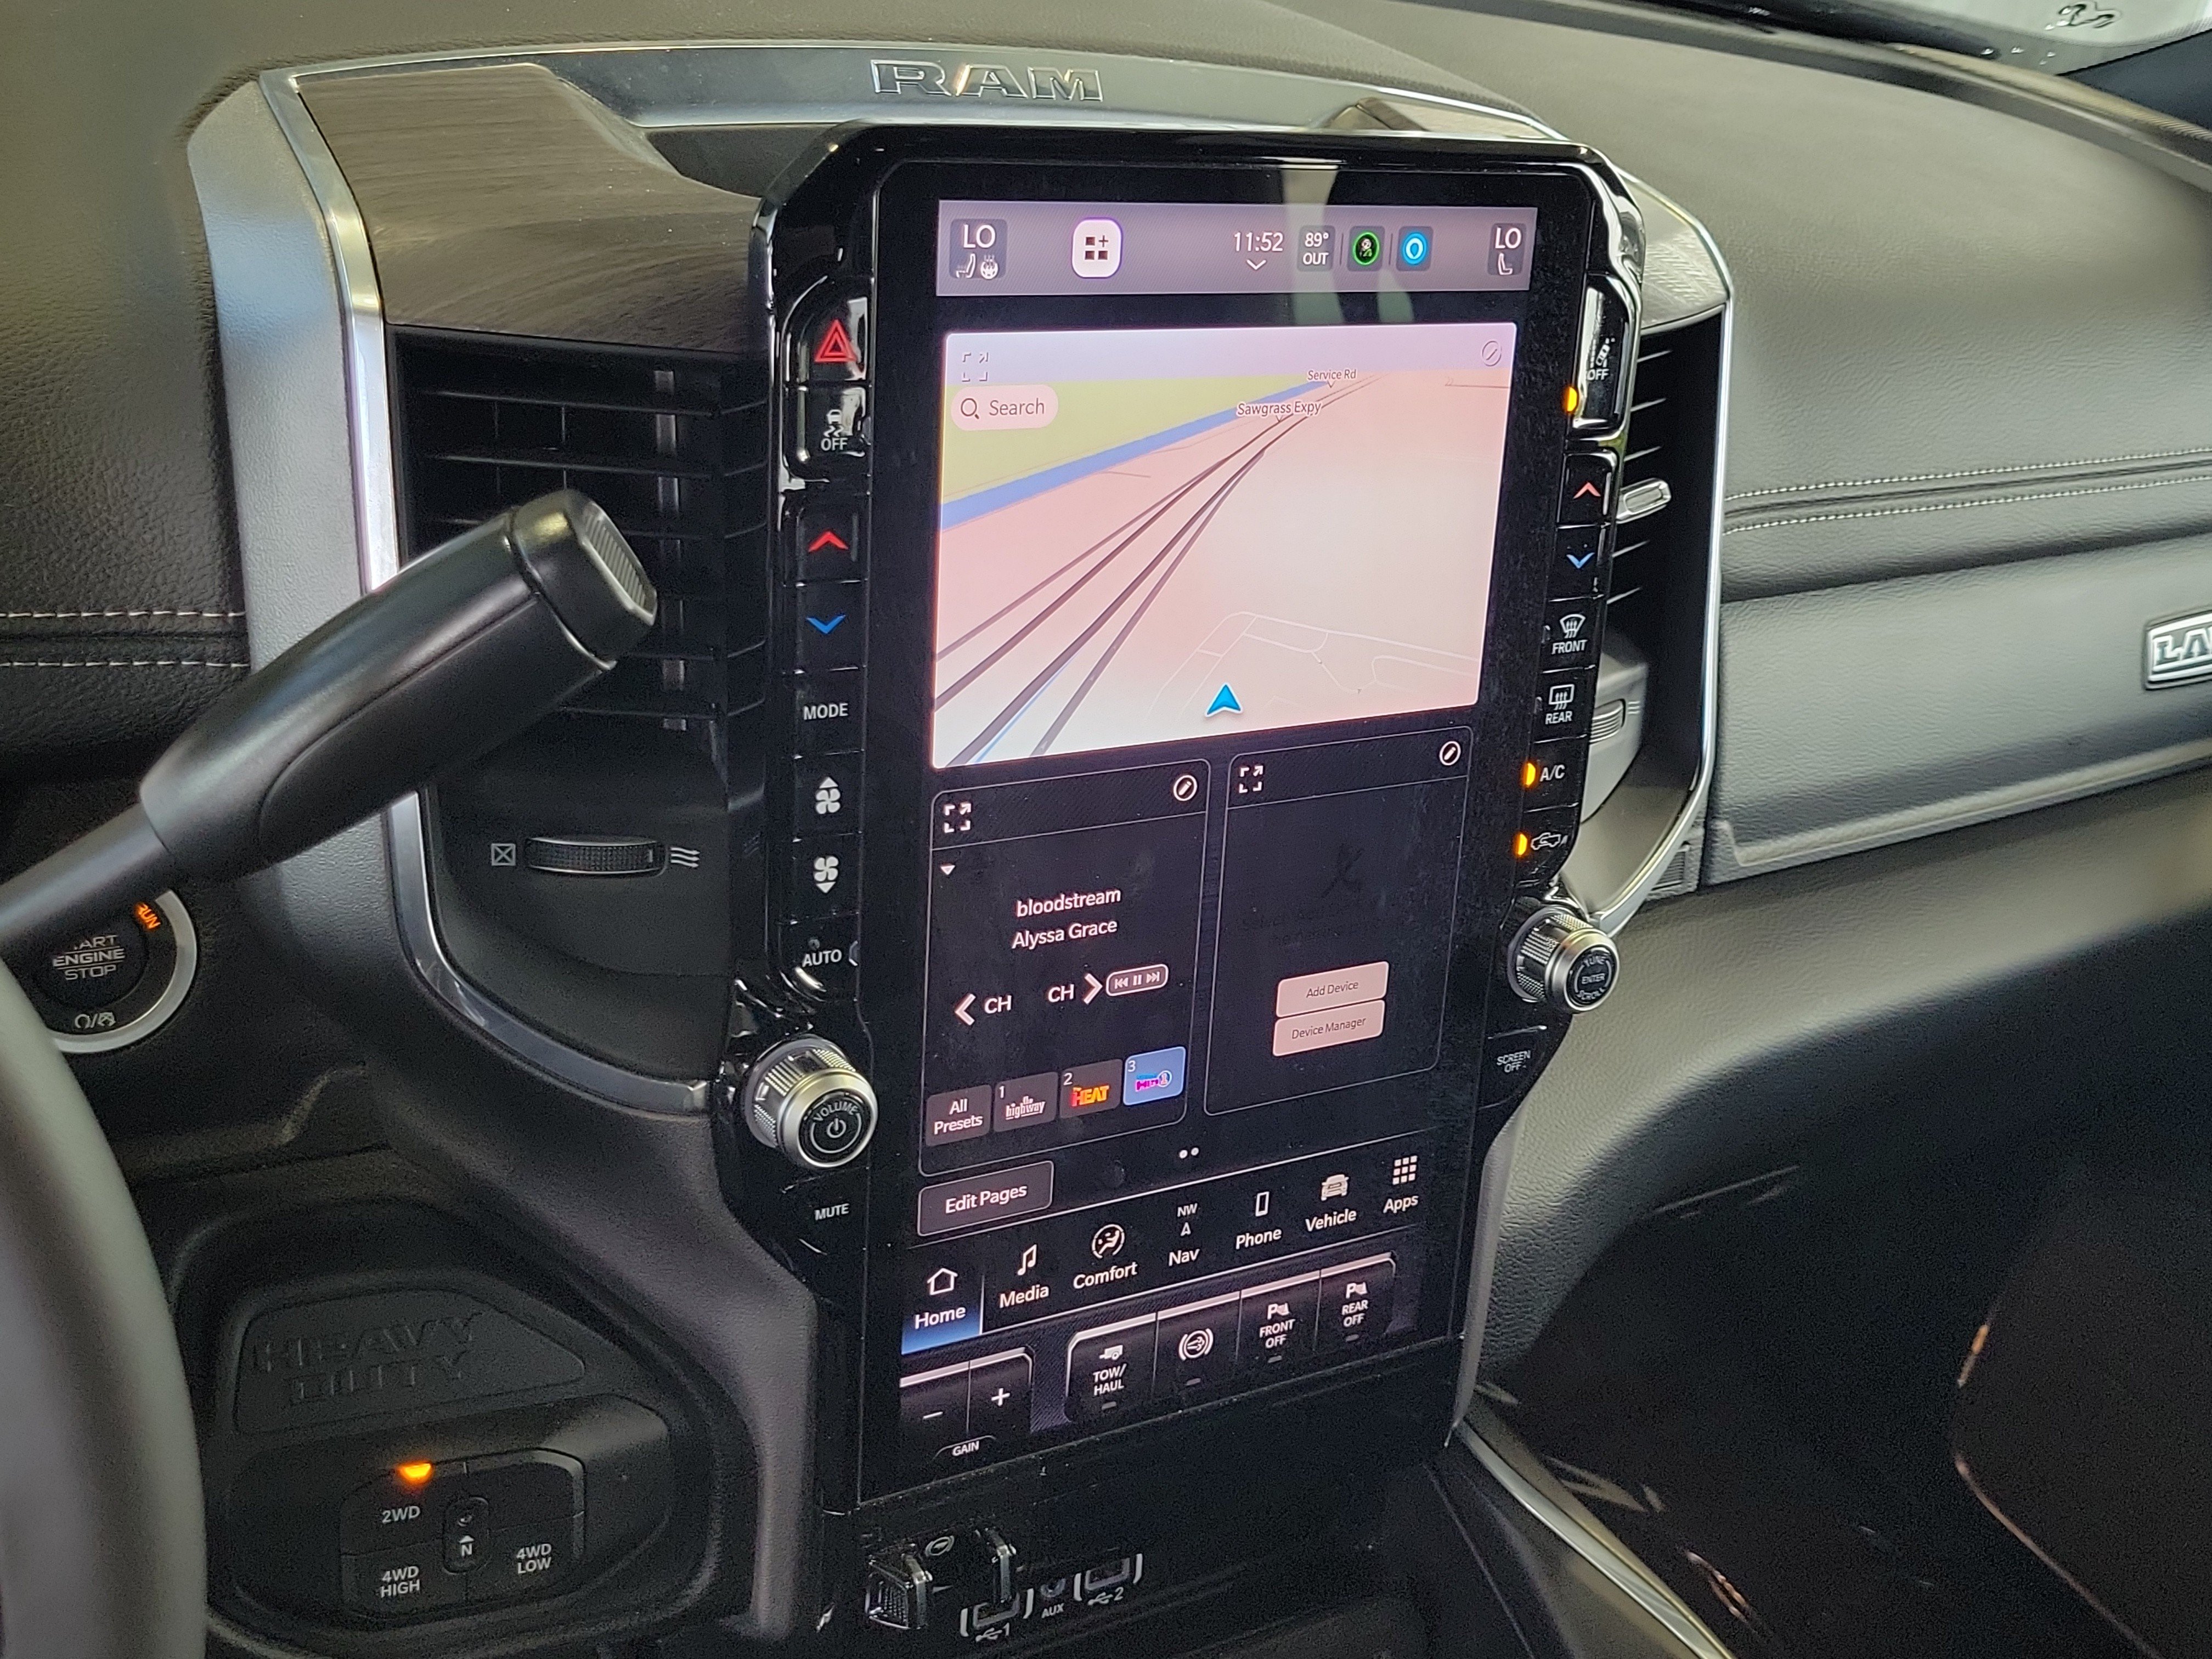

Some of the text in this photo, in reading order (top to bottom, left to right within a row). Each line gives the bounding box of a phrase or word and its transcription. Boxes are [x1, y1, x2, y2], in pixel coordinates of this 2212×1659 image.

[870, 59, 1103, 103] RAM
[963, 224, 996, 248] LO
[1234, 232, 1284, 252] 11:52
[1304, 232, 1329, 248] 89°
[1493, 227, 1522, 250] LO
[1302, 252, 1329, 265] OUT
[1307, 369, 1357, 380] Service Rd
[1585, 368, 1609, 381] OFF
[989, 398, 1046, 417] Search
[1237, 400, 1322, 417] Sawgrass Expy
[820, 437, 848, 451] OFF
[1551, 639, 1588, 654] FRONT
[803, 703, 849, 720] MODE
[1544, 710, 1572, 725] REAR
[1539, 764, 1566, 782] A/C
[1016, 888, 1121, 917] bloodstream
[136, 902, 161, 929] RUN
[1012, 919, 1118, 950] Alyssa Grace
[52, 948, 126, 968] ENGINE
[802, 949, 843, 967] AUTO
[65, 964, 117, 981] STOP
[1048, 984, 1075, 1003] CH
[1306, 980, 1359, 998] Add Device
[984, 994, 1012, 1015] CH
[1291, 1017, 1367, 1040] Device Manager
[1127, 1059, 1136, 1073] 3
[1496, 1050, 1532, 1065] SCREEN
[1504, 1063, 1522, 1073] OFF
[1063, 1072, 1073, 1086] 2
[998, 1085, 1005, 1099] 1
[1071, 1086, 1110, 1107] HEAT
[812, 1101, 860, 1123] VOLUME
[949, 1098, 968, 1114] All
[1005, 1101, 1046, 1120] highway
[934, 1114, 983, 1135] Presets
[945, 1185, 1028, 1214] Edit Pages
[1383, 1195, 1419, 1214] Apps
[814, 1203, 850, 1221] MUTE
[1177, 1203, 1198, 1218] NW
[1305, 1208, 1357, 1232] Vehicle
[1235, 1228, 1282, 1250] Phone
[1167, 1248, 1200, 1266] Nav
[1073, 1261, 1139, 1289] Comfort
[999, 1284, 1049, 1308] Media
[914, 1305, 966, 1329] Home
[1341, 1300, 1369, 1316] REAR
[1259, 1318, 1295, 1338] FRONT
[1343, 1313, 1365, 1328] OFF
[1265, 1334, 1288, 1349] OFF
[1092, 1363, 1127, 1383] TOW/
[1093, 1378, 1125, 1396] HAUL
[952, 1440, 980, 1457] GAIN
[382, 1505, 421, 1523] 2WD
[460, 1543, 473, 1557] N
[516, 1543, 552, 1560] 4WD
[382, 1565, 420, 1583] 4WD
[517, 1556, 552, 1574] LOW
[380, 1579, 421, 1598] HIGH
[1042, 1602, 1064, 1618] AUX
